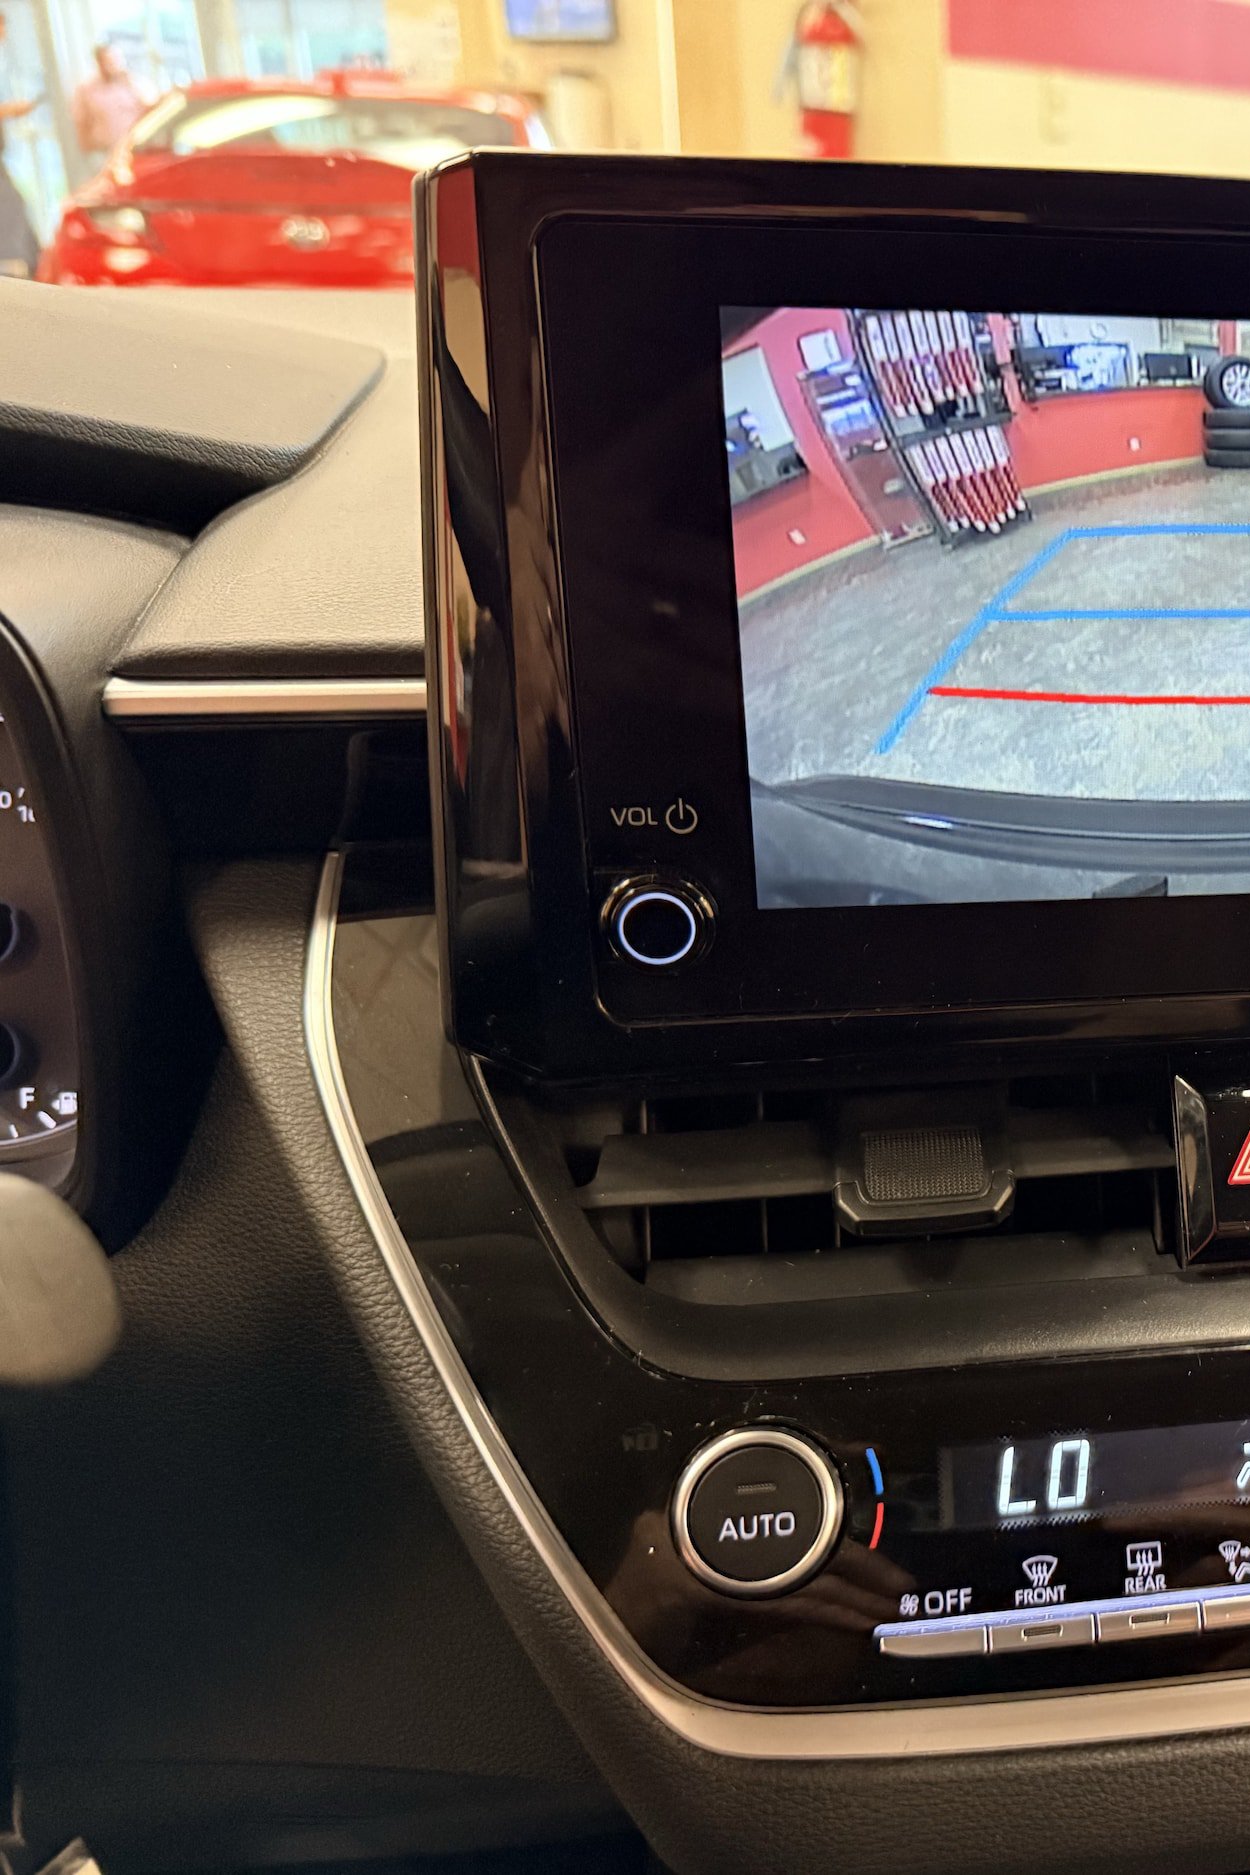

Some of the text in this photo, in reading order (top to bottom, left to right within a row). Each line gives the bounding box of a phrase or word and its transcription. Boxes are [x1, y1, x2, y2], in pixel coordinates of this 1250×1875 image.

[610, 807, 658, 827] VOL
[19, 1086, 36, 1110] F
[998, 1439, 1090, 1515] LO
[718, 1511, 796, 1542] AUTO
[1014, 1584, 1067, 1606] FRONT
[1125, 1573, 1167, 1595] REAR
[924, 1587, 973, 1616] OFF
